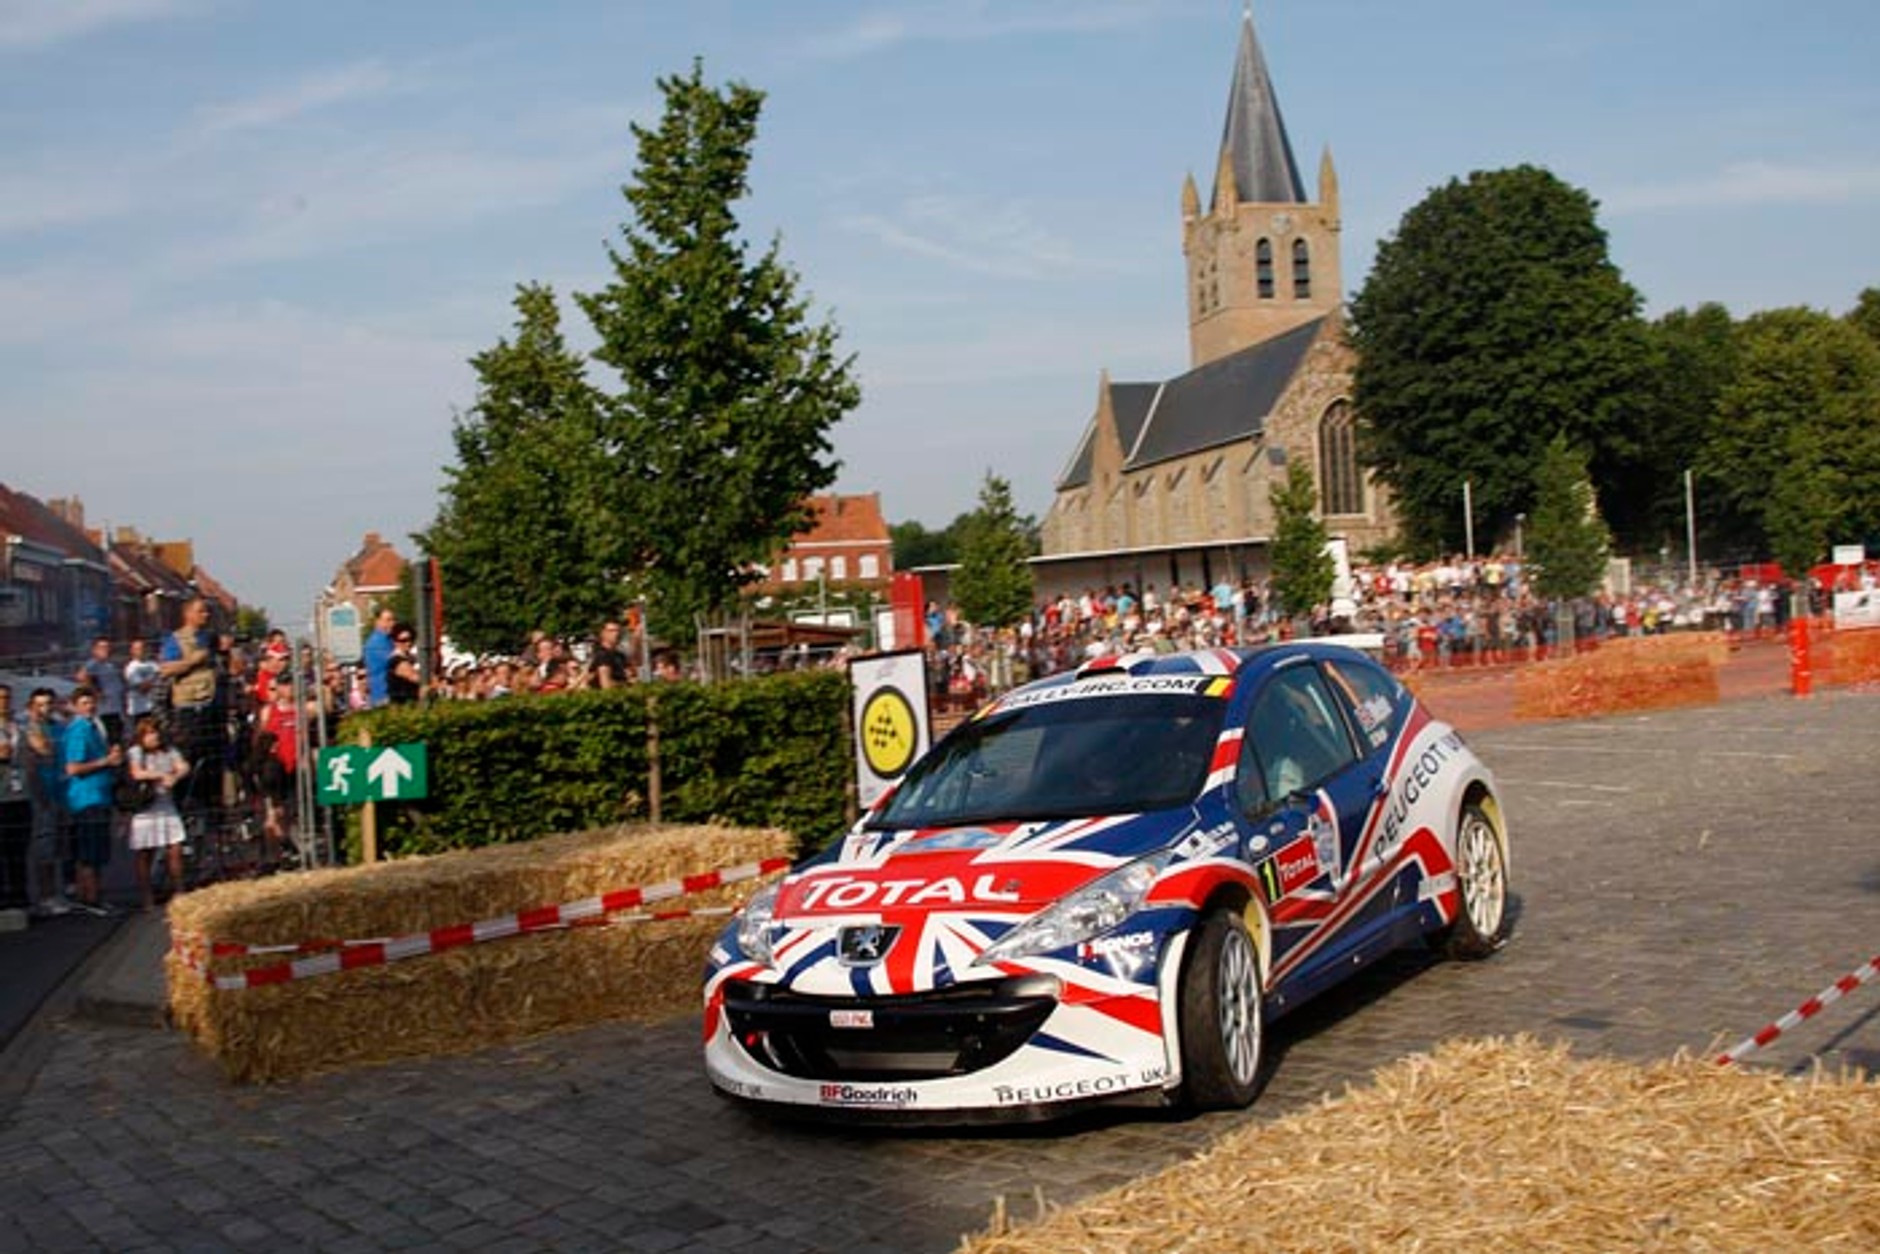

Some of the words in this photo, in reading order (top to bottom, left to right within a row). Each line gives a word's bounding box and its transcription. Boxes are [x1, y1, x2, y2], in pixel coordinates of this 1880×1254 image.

[1374, 743, 1447, 863] PEUGEOT
[1264, 861, 1277, 901] 1
[1281, 853, 1315, 881] TOTAL
[801, 874, 1020, 910] TOTAL
[819, 1084, 917, 1101] BFGoodrich
[992, 1074, 1130, 1103] PEUGEOT
[1140, 1067, 1165, 1083] UK
